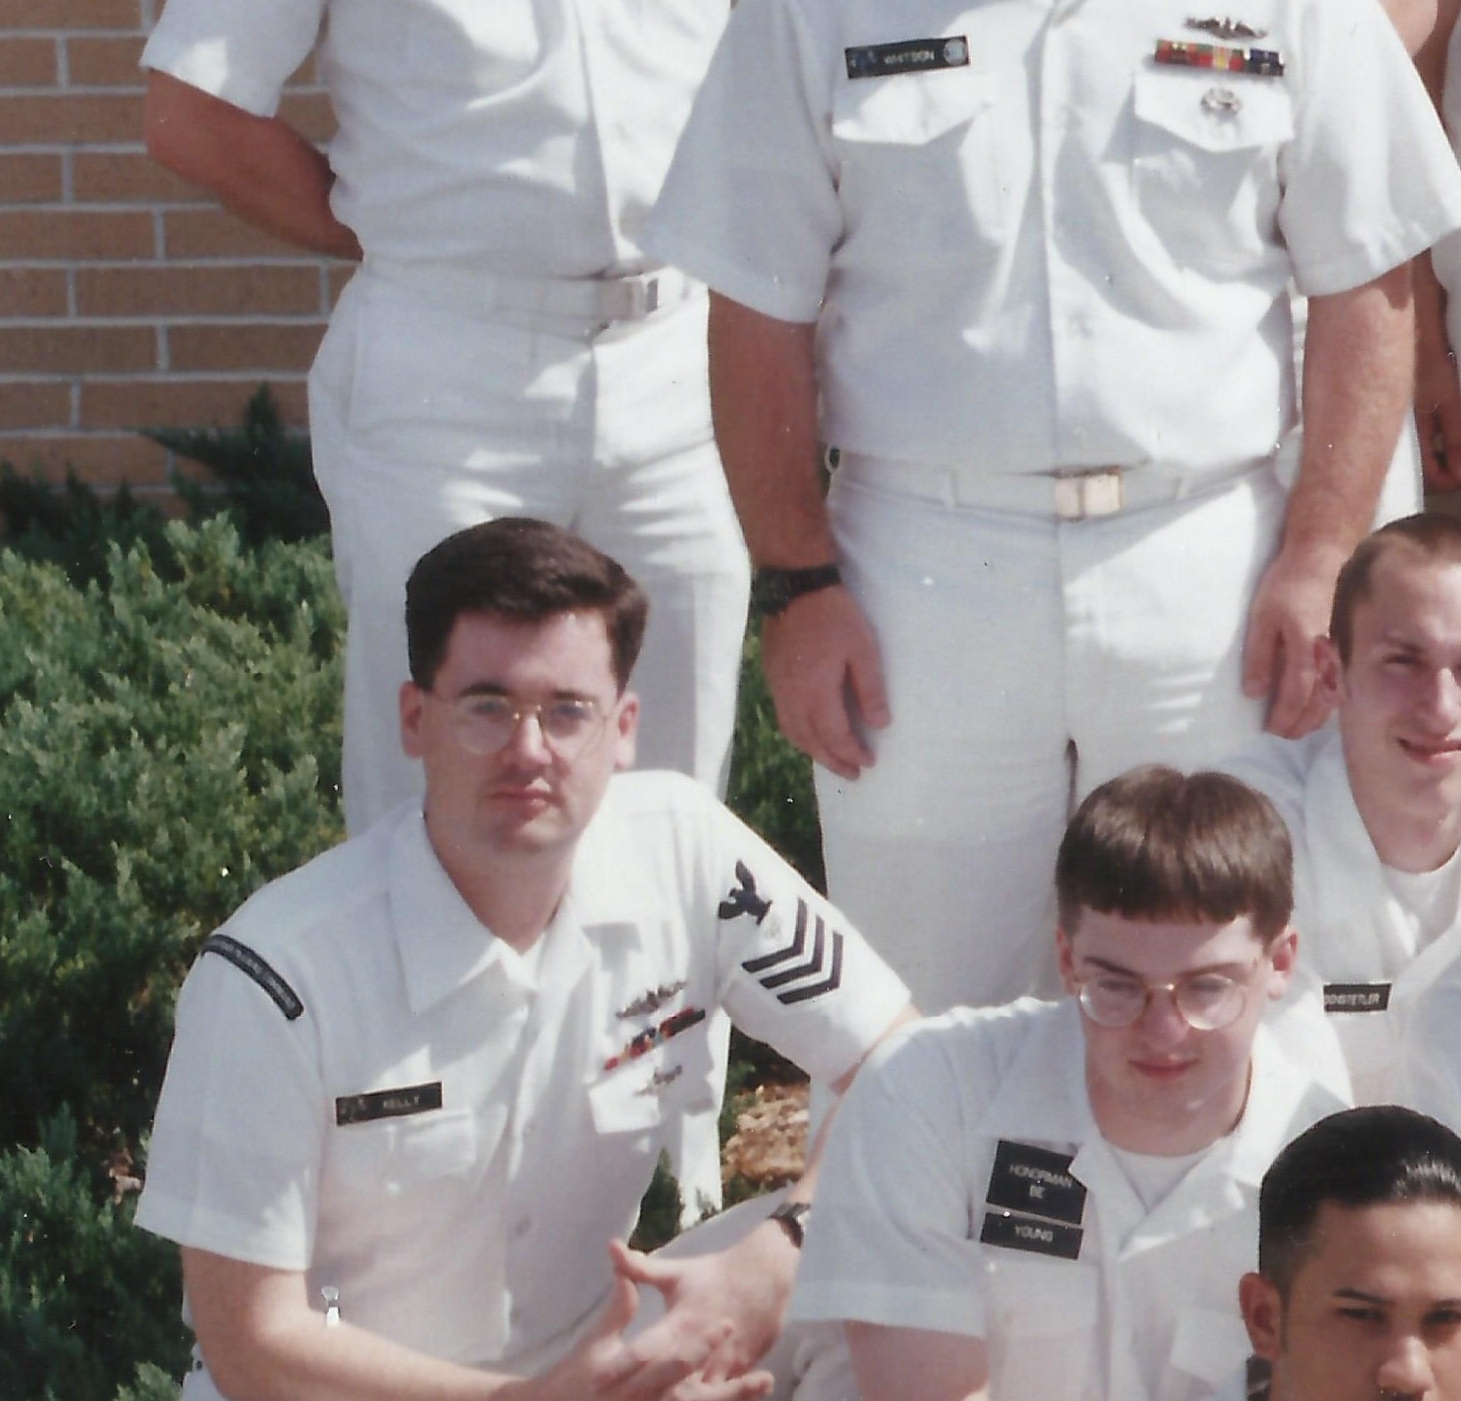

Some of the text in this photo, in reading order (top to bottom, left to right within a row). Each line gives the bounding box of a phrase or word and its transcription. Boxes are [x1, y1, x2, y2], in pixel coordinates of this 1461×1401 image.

[884, 50, 936, 65] WHITSON
[1010, 1164, 1073, 1188] HONORMAN
[1014, 1225, 1055, 1243] YOUNG
